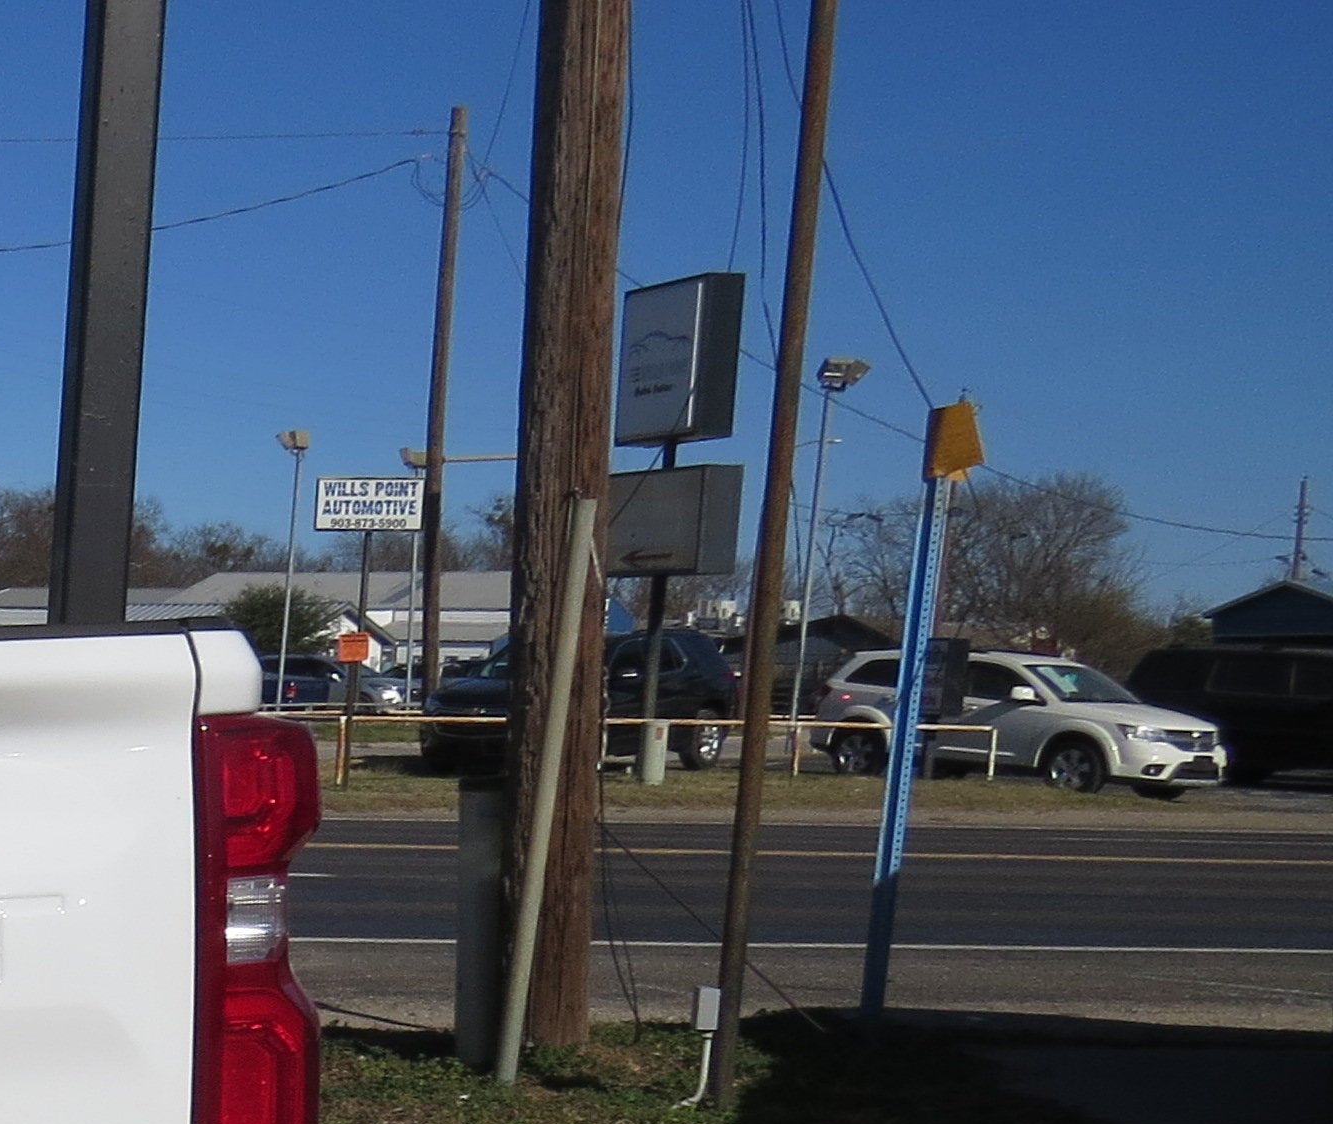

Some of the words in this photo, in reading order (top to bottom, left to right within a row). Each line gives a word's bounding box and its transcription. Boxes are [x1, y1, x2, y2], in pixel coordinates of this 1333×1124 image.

[324, 482, 369, 496] WILLS
[375, 482, 418, 496] POINT
[322, 500, 417, 515] AUTOMOTIVE
